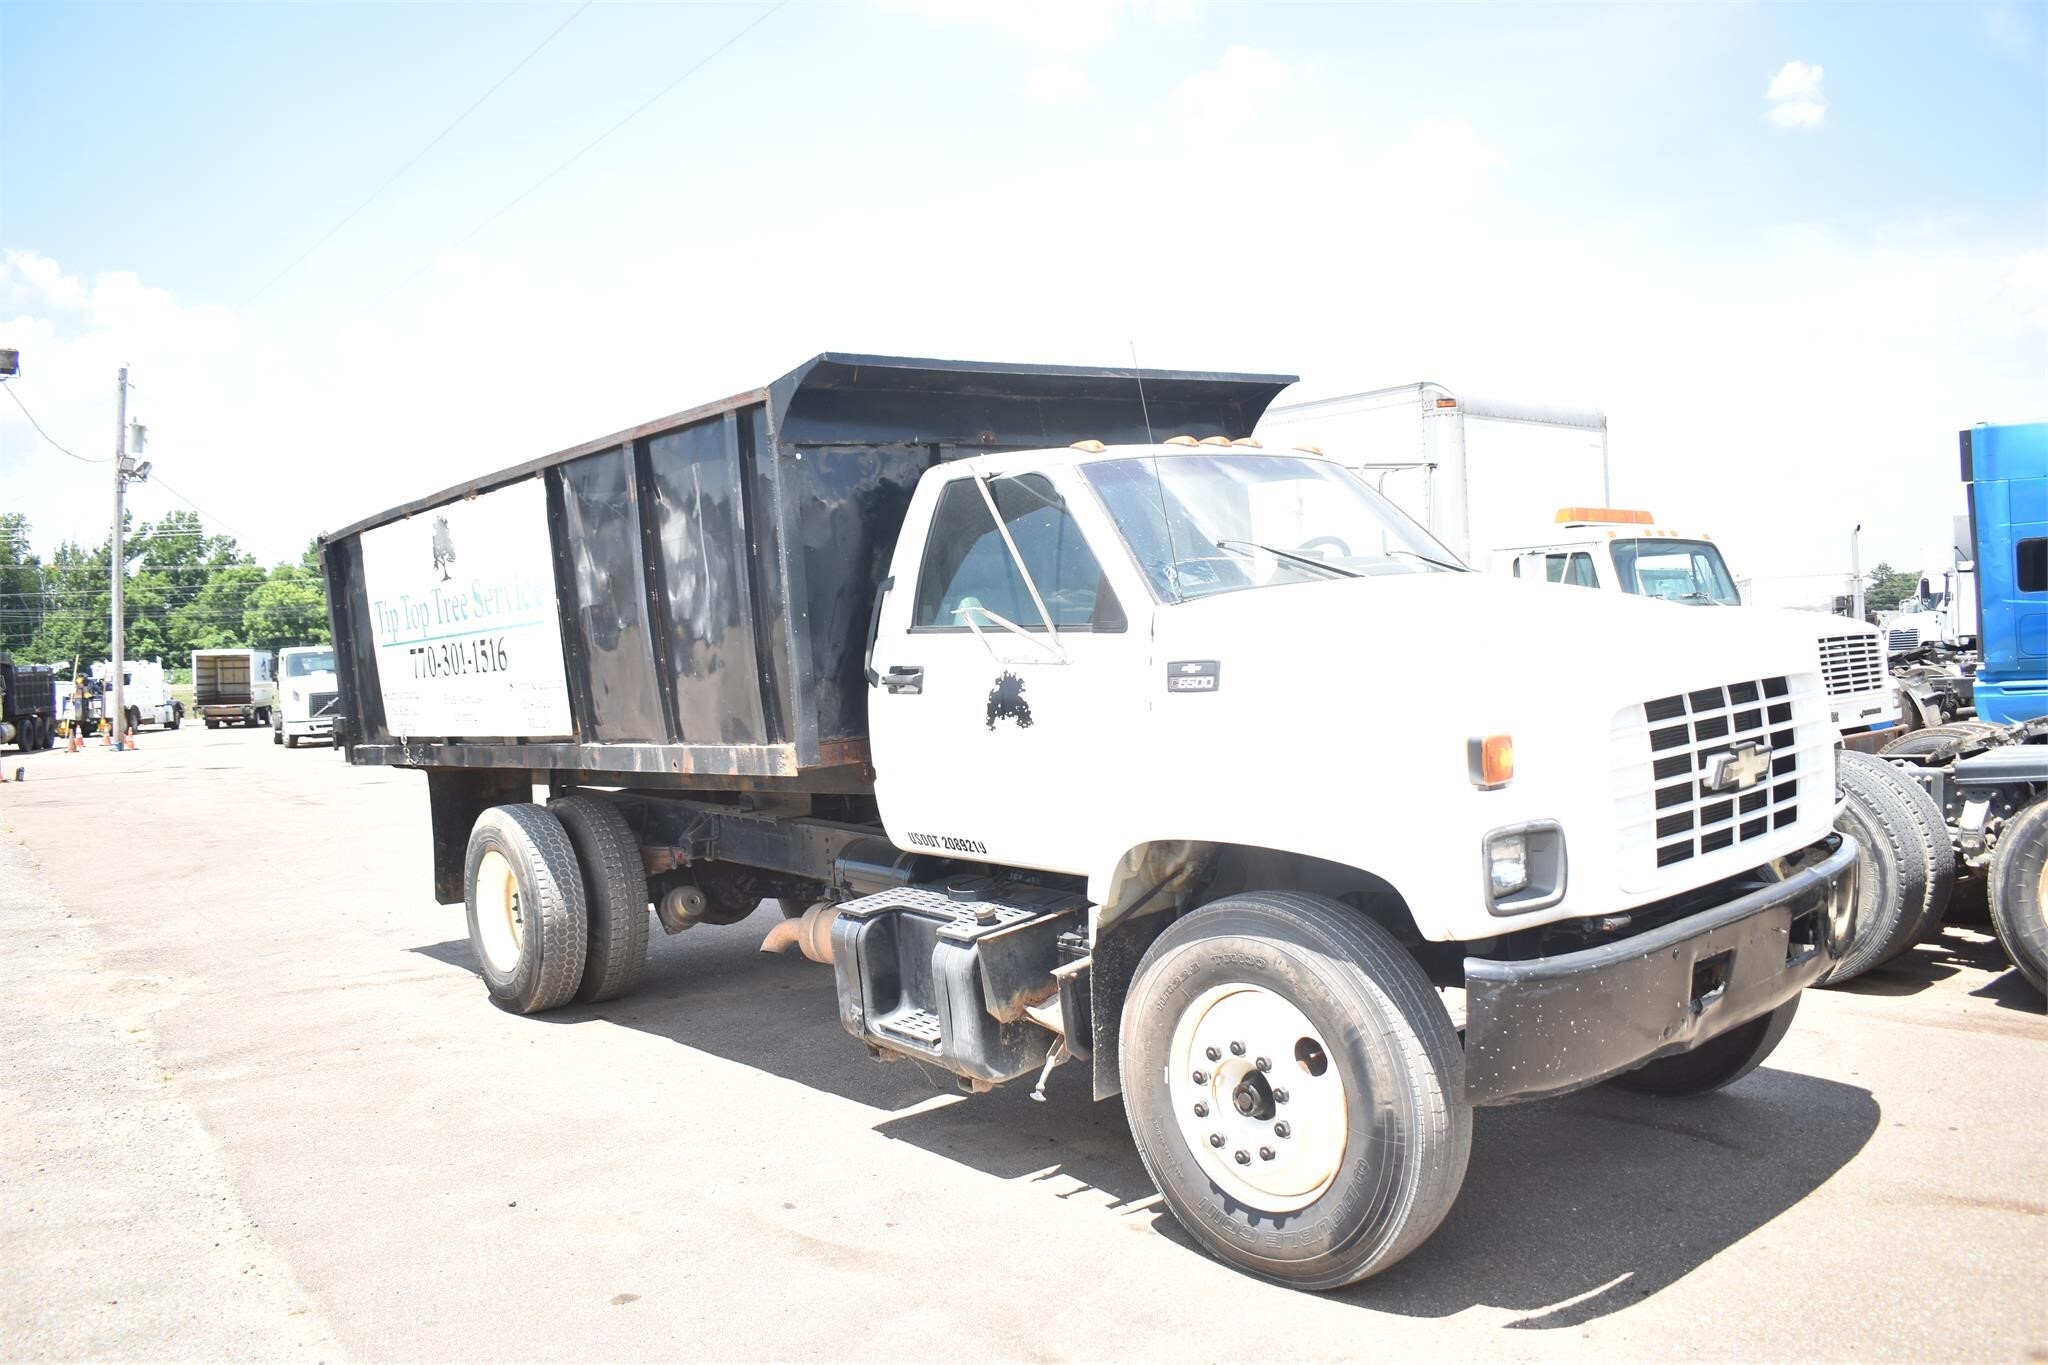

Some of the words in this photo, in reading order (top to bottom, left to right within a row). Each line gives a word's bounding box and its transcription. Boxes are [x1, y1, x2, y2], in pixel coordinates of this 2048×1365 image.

[374, 600, 399, 642] Tip
[400, 595, 430, 637] Top
[432, 588, 468, 624] Tree
[410, 637, 508, 679] 770-301-1516
[907, 831, 941, 849] USDOT
